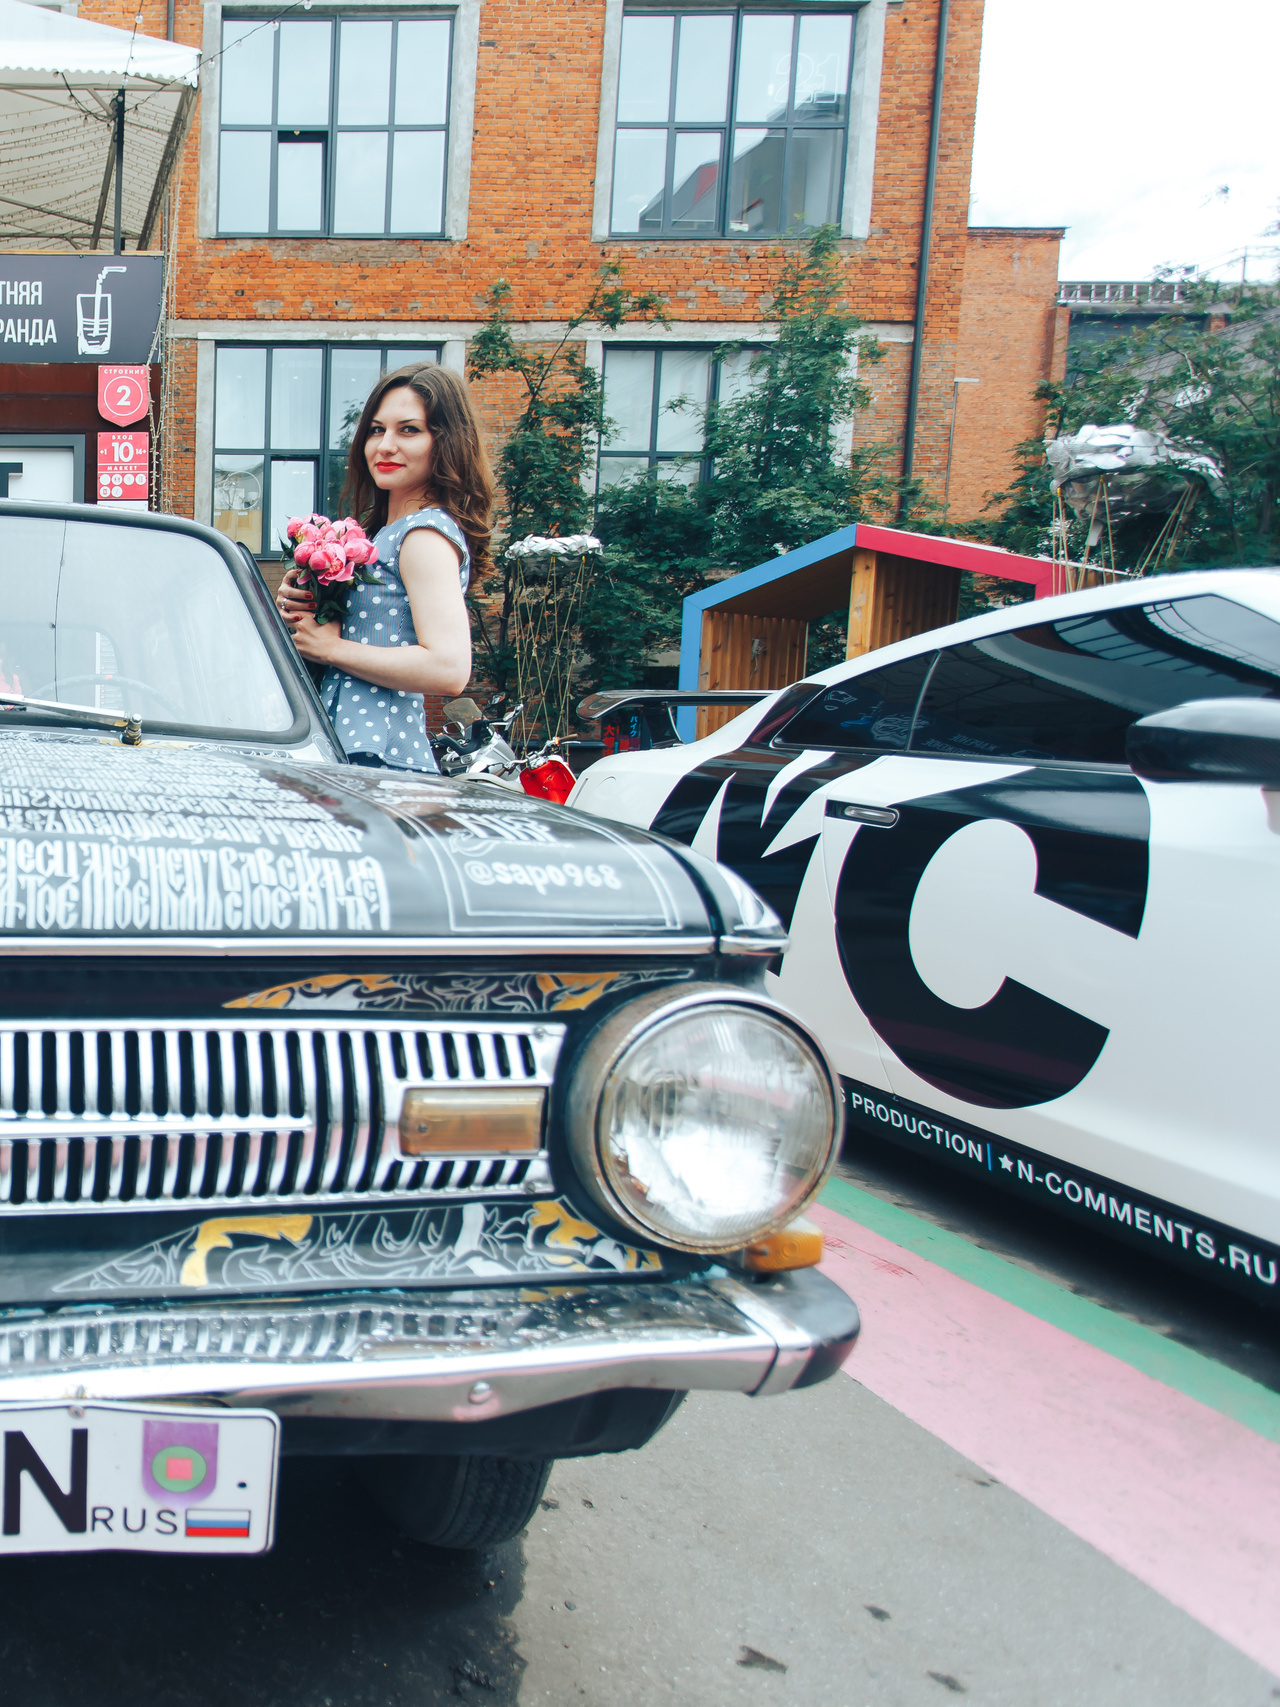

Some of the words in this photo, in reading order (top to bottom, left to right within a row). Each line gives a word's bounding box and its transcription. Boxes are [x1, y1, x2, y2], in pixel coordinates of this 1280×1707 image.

[116, 385, 131, 406] 2
[111, 441, 134, 462] 10
[852, 1091, 984, 1163] PRODUCTION
[1017, 1159, 1278, 1286] N-COMMENTS.RU
[91, 1506, 180, 1537] RUS
